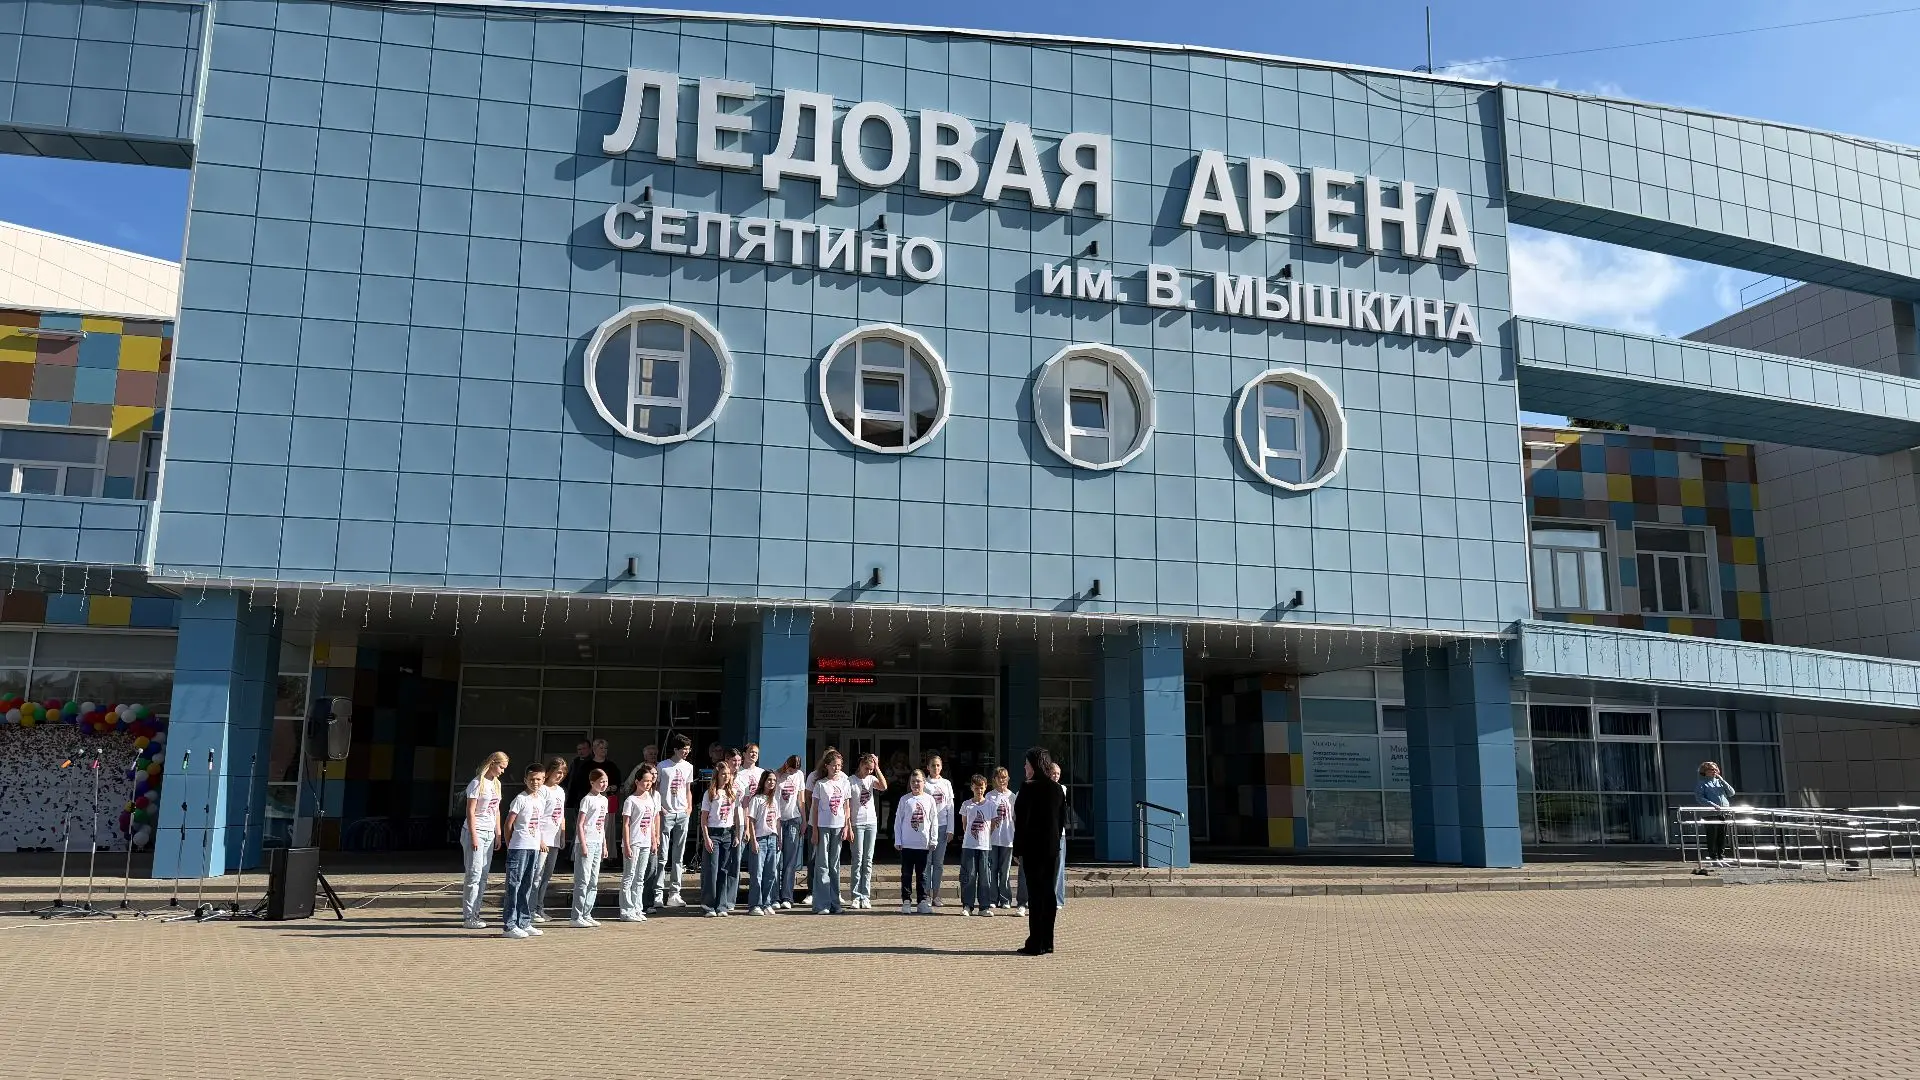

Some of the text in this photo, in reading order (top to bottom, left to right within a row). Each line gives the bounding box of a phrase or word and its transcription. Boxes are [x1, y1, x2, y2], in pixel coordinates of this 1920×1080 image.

[602, 67, 1478, 267] ЛЕДОВАЯ АРЕНА
[603, 203, 944, 283] СЕЛЯТИНО
[1147, 264, 1197, 310] В.
[1213, 271, 1482, 344] МЫШКИНА
